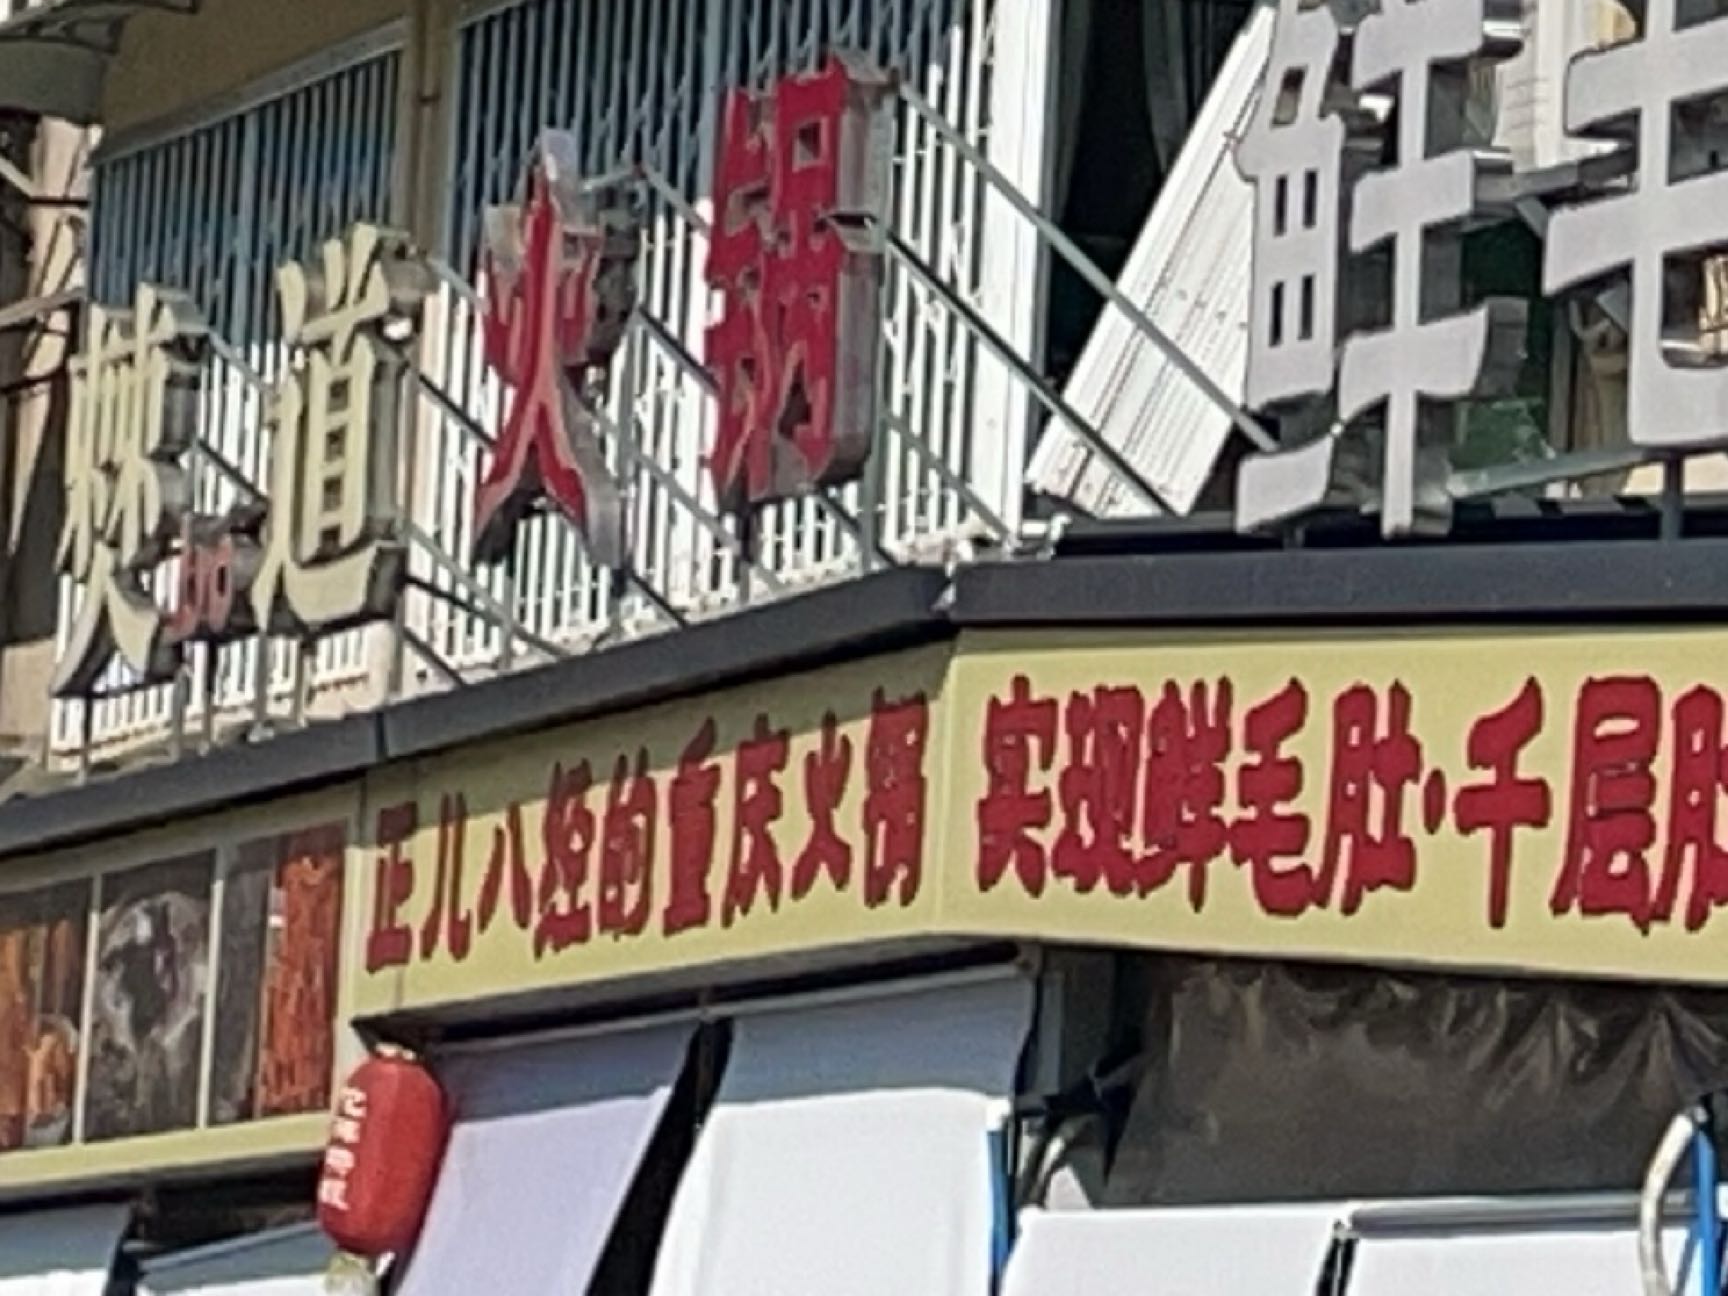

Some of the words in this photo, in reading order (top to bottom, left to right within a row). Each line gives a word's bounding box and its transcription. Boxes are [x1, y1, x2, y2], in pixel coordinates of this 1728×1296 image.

[366, 685, 929, 974] 正儿八经的重庆火锅
